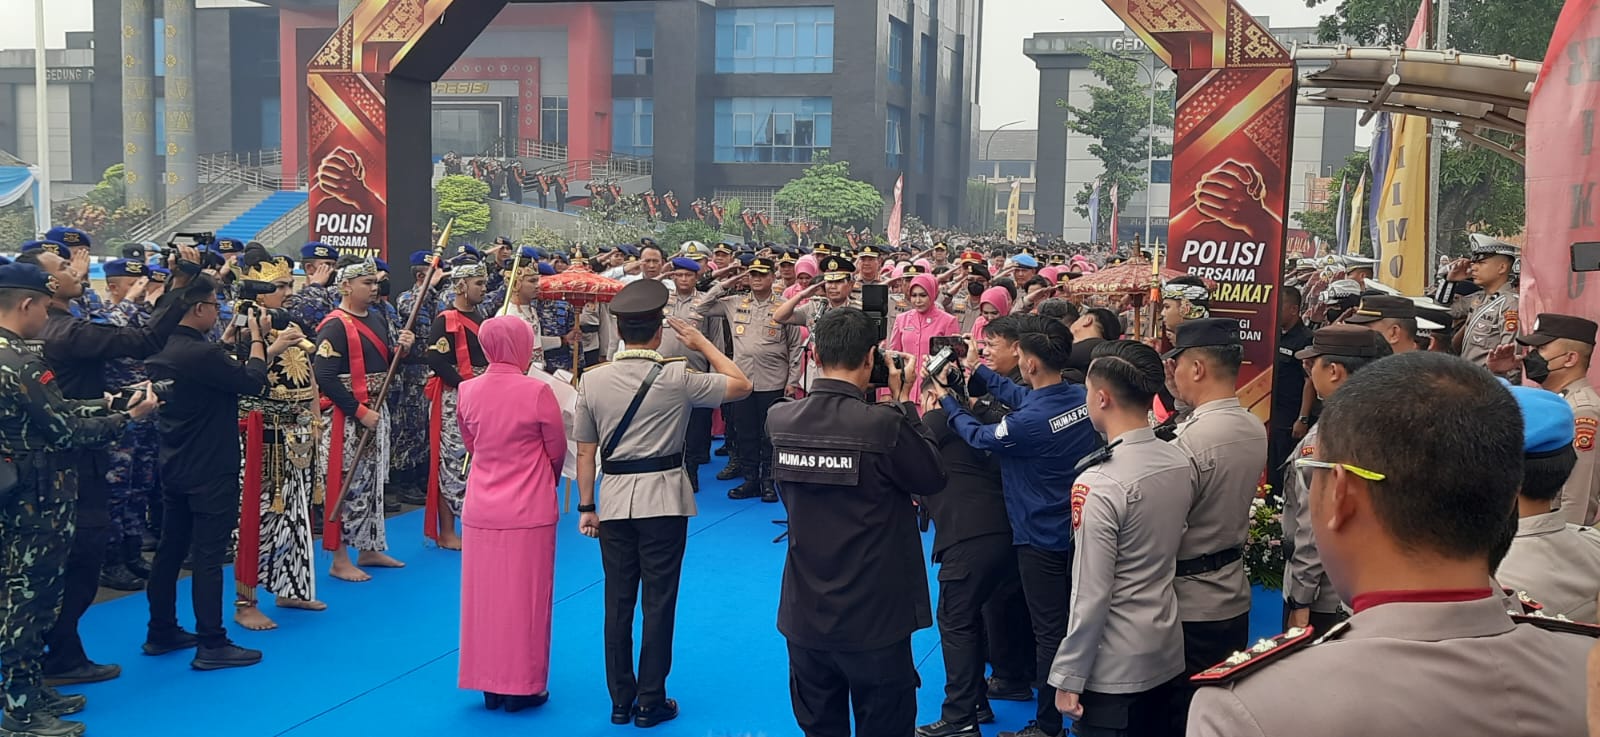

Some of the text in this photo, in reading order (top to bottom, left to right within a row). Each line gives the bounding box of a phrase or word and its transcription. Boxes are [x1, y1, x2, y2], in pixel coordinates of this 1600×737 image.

[1112, 38, 1145, 50] GED
[45, 69, 82, 80] GEDUNG
[315, 213, 373, 234] POLISI
[320, 235, 368, 247] BERSAMA
[1181, 240, 1265, 266] POLISI
[1187, 266, 1256, 282] BERSAMA
[1209, 282, 1273, 303] ARAKAT
[1238, 319, 1250, 329] GI
[1240, 330, 1261, 341] DAN
[1052, 406, 1088, 430] HUMAS PO
[778, 452, 853, 468] HUMAS POLRI
